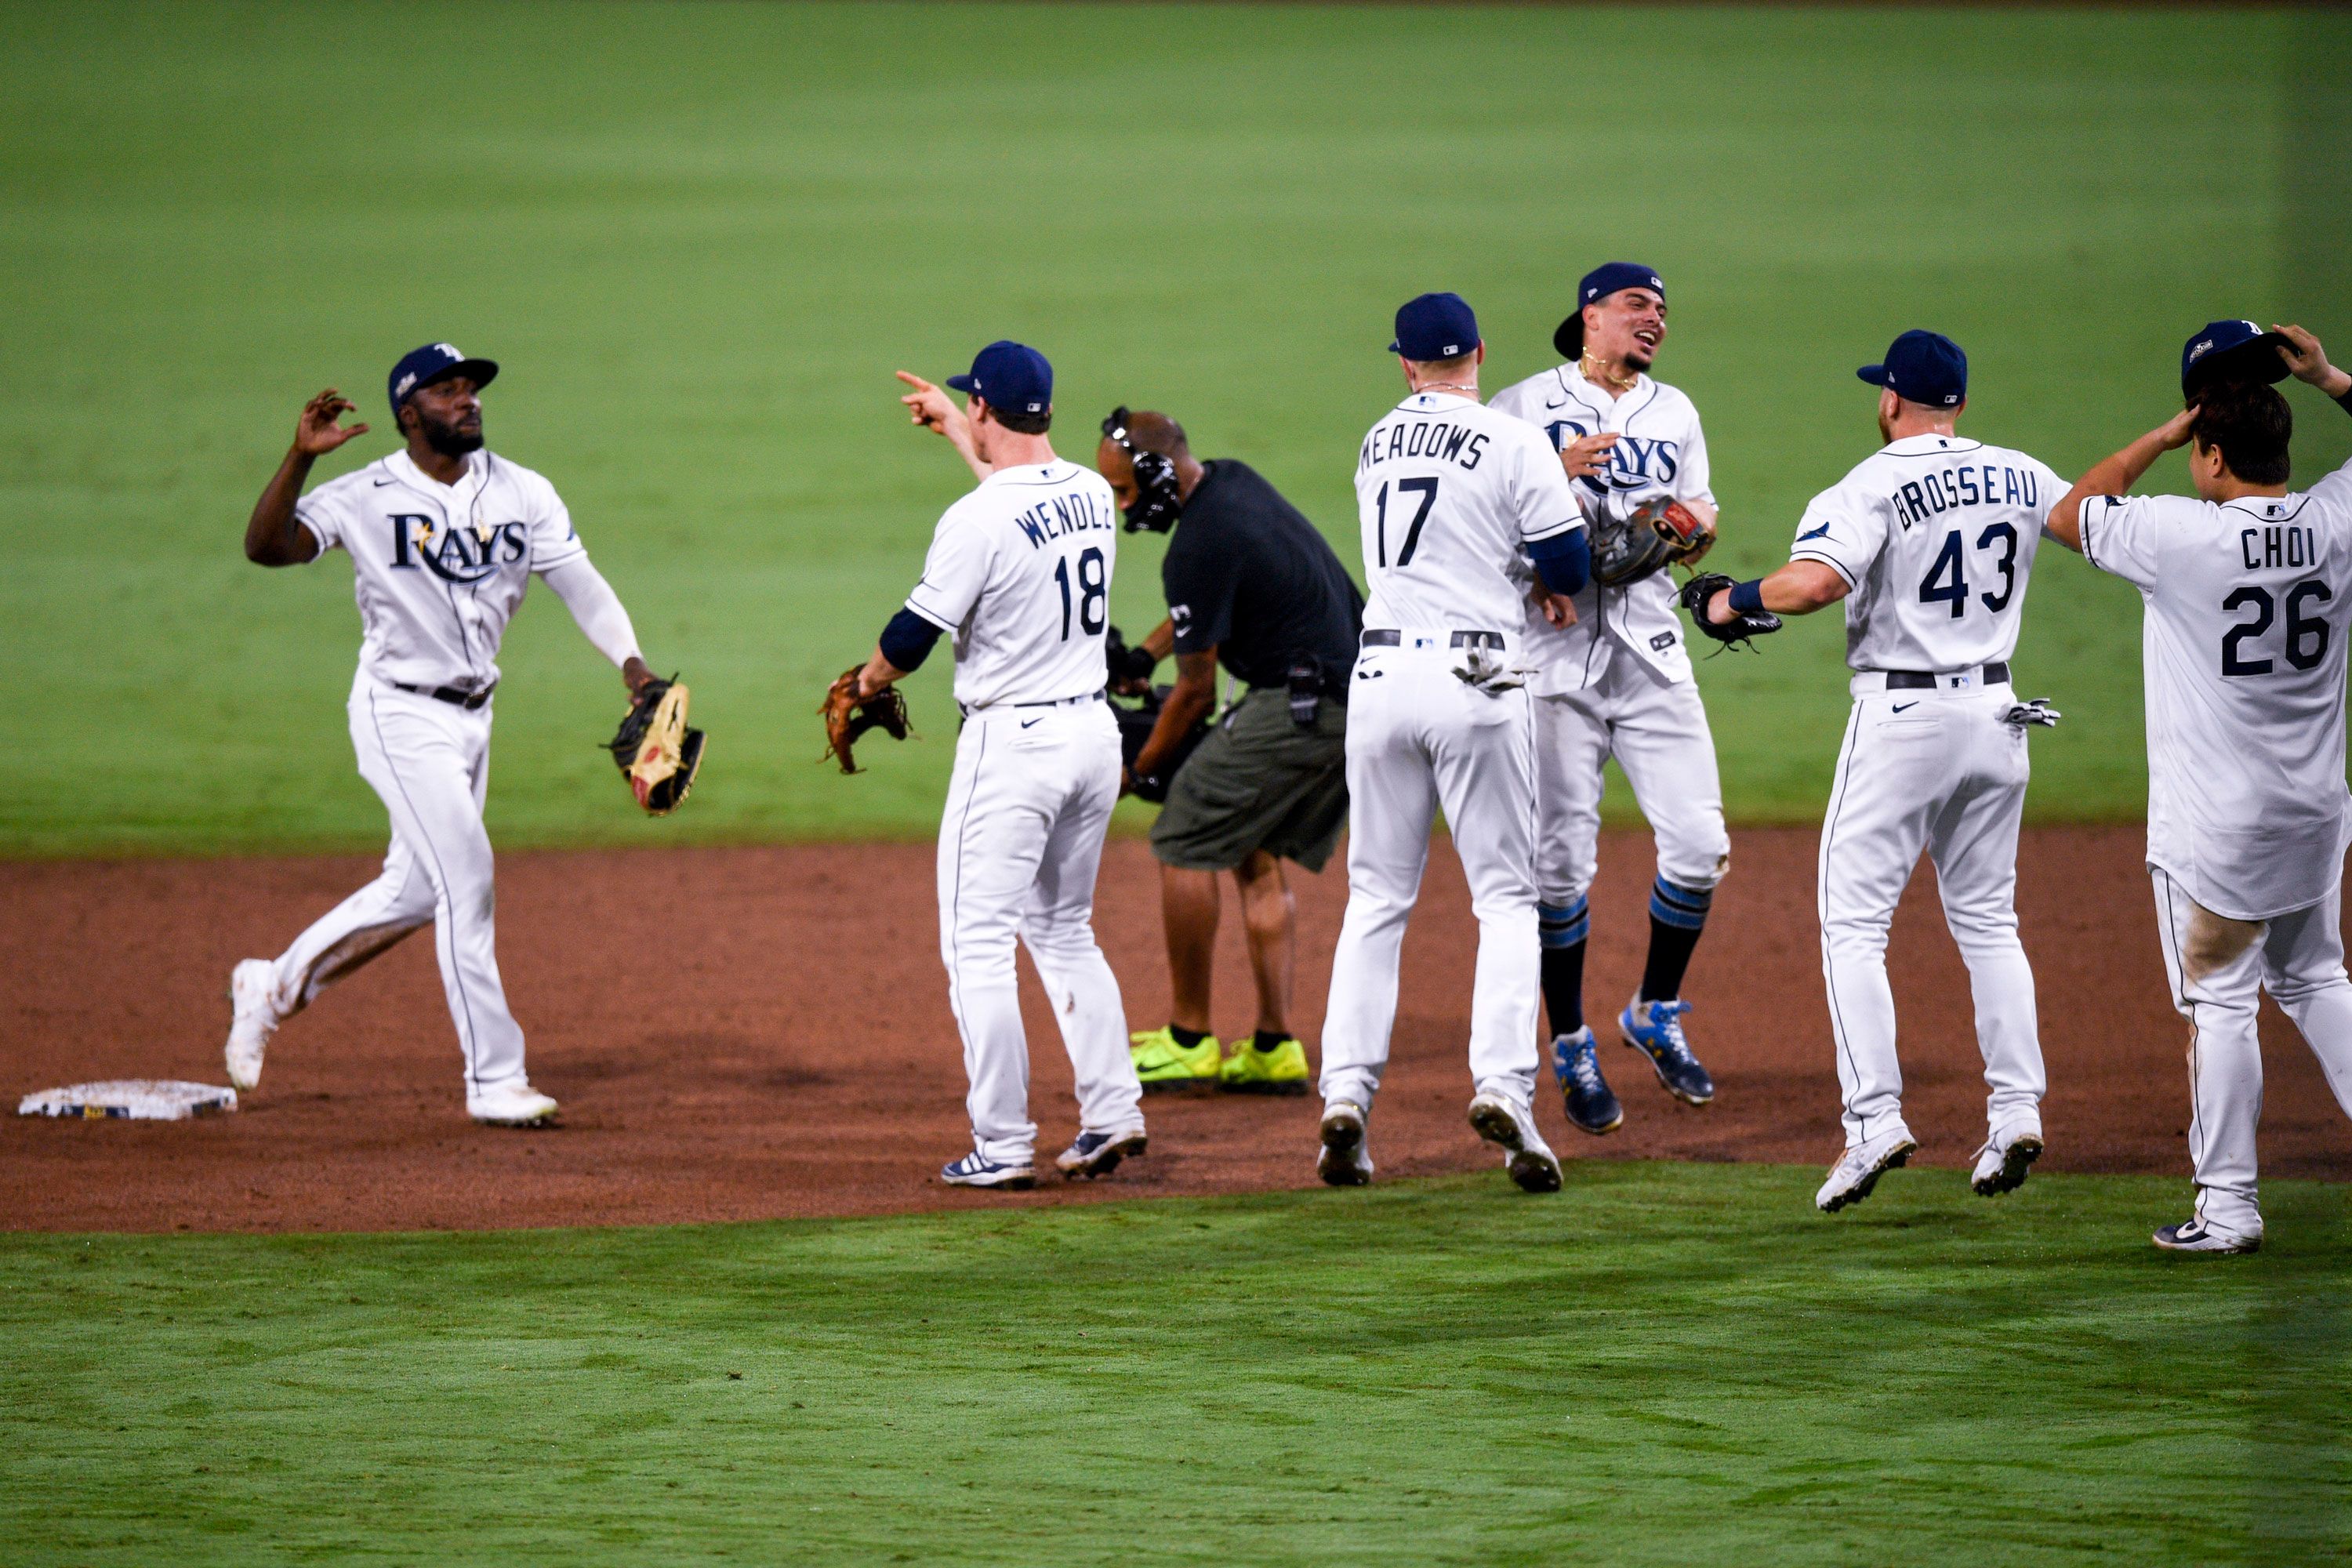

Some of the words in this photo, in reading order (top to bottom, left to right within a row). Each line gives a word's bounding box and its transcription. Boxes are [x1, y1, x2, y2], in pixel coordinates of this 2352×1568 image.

[1361, 422, 1490, 476] MEADOWS
[1377, 477, 1439, 568] 17
[1892, 465, 2037, 532] BROSSEAU
[387, 514, 527, 586] RAYS
[1919, 521, 2018, 619] 43
[2241, 526, 2315, 570] CHOI
[1054, 546, 1105, 642] 18
[2222, 579, 2332, 677] 26
